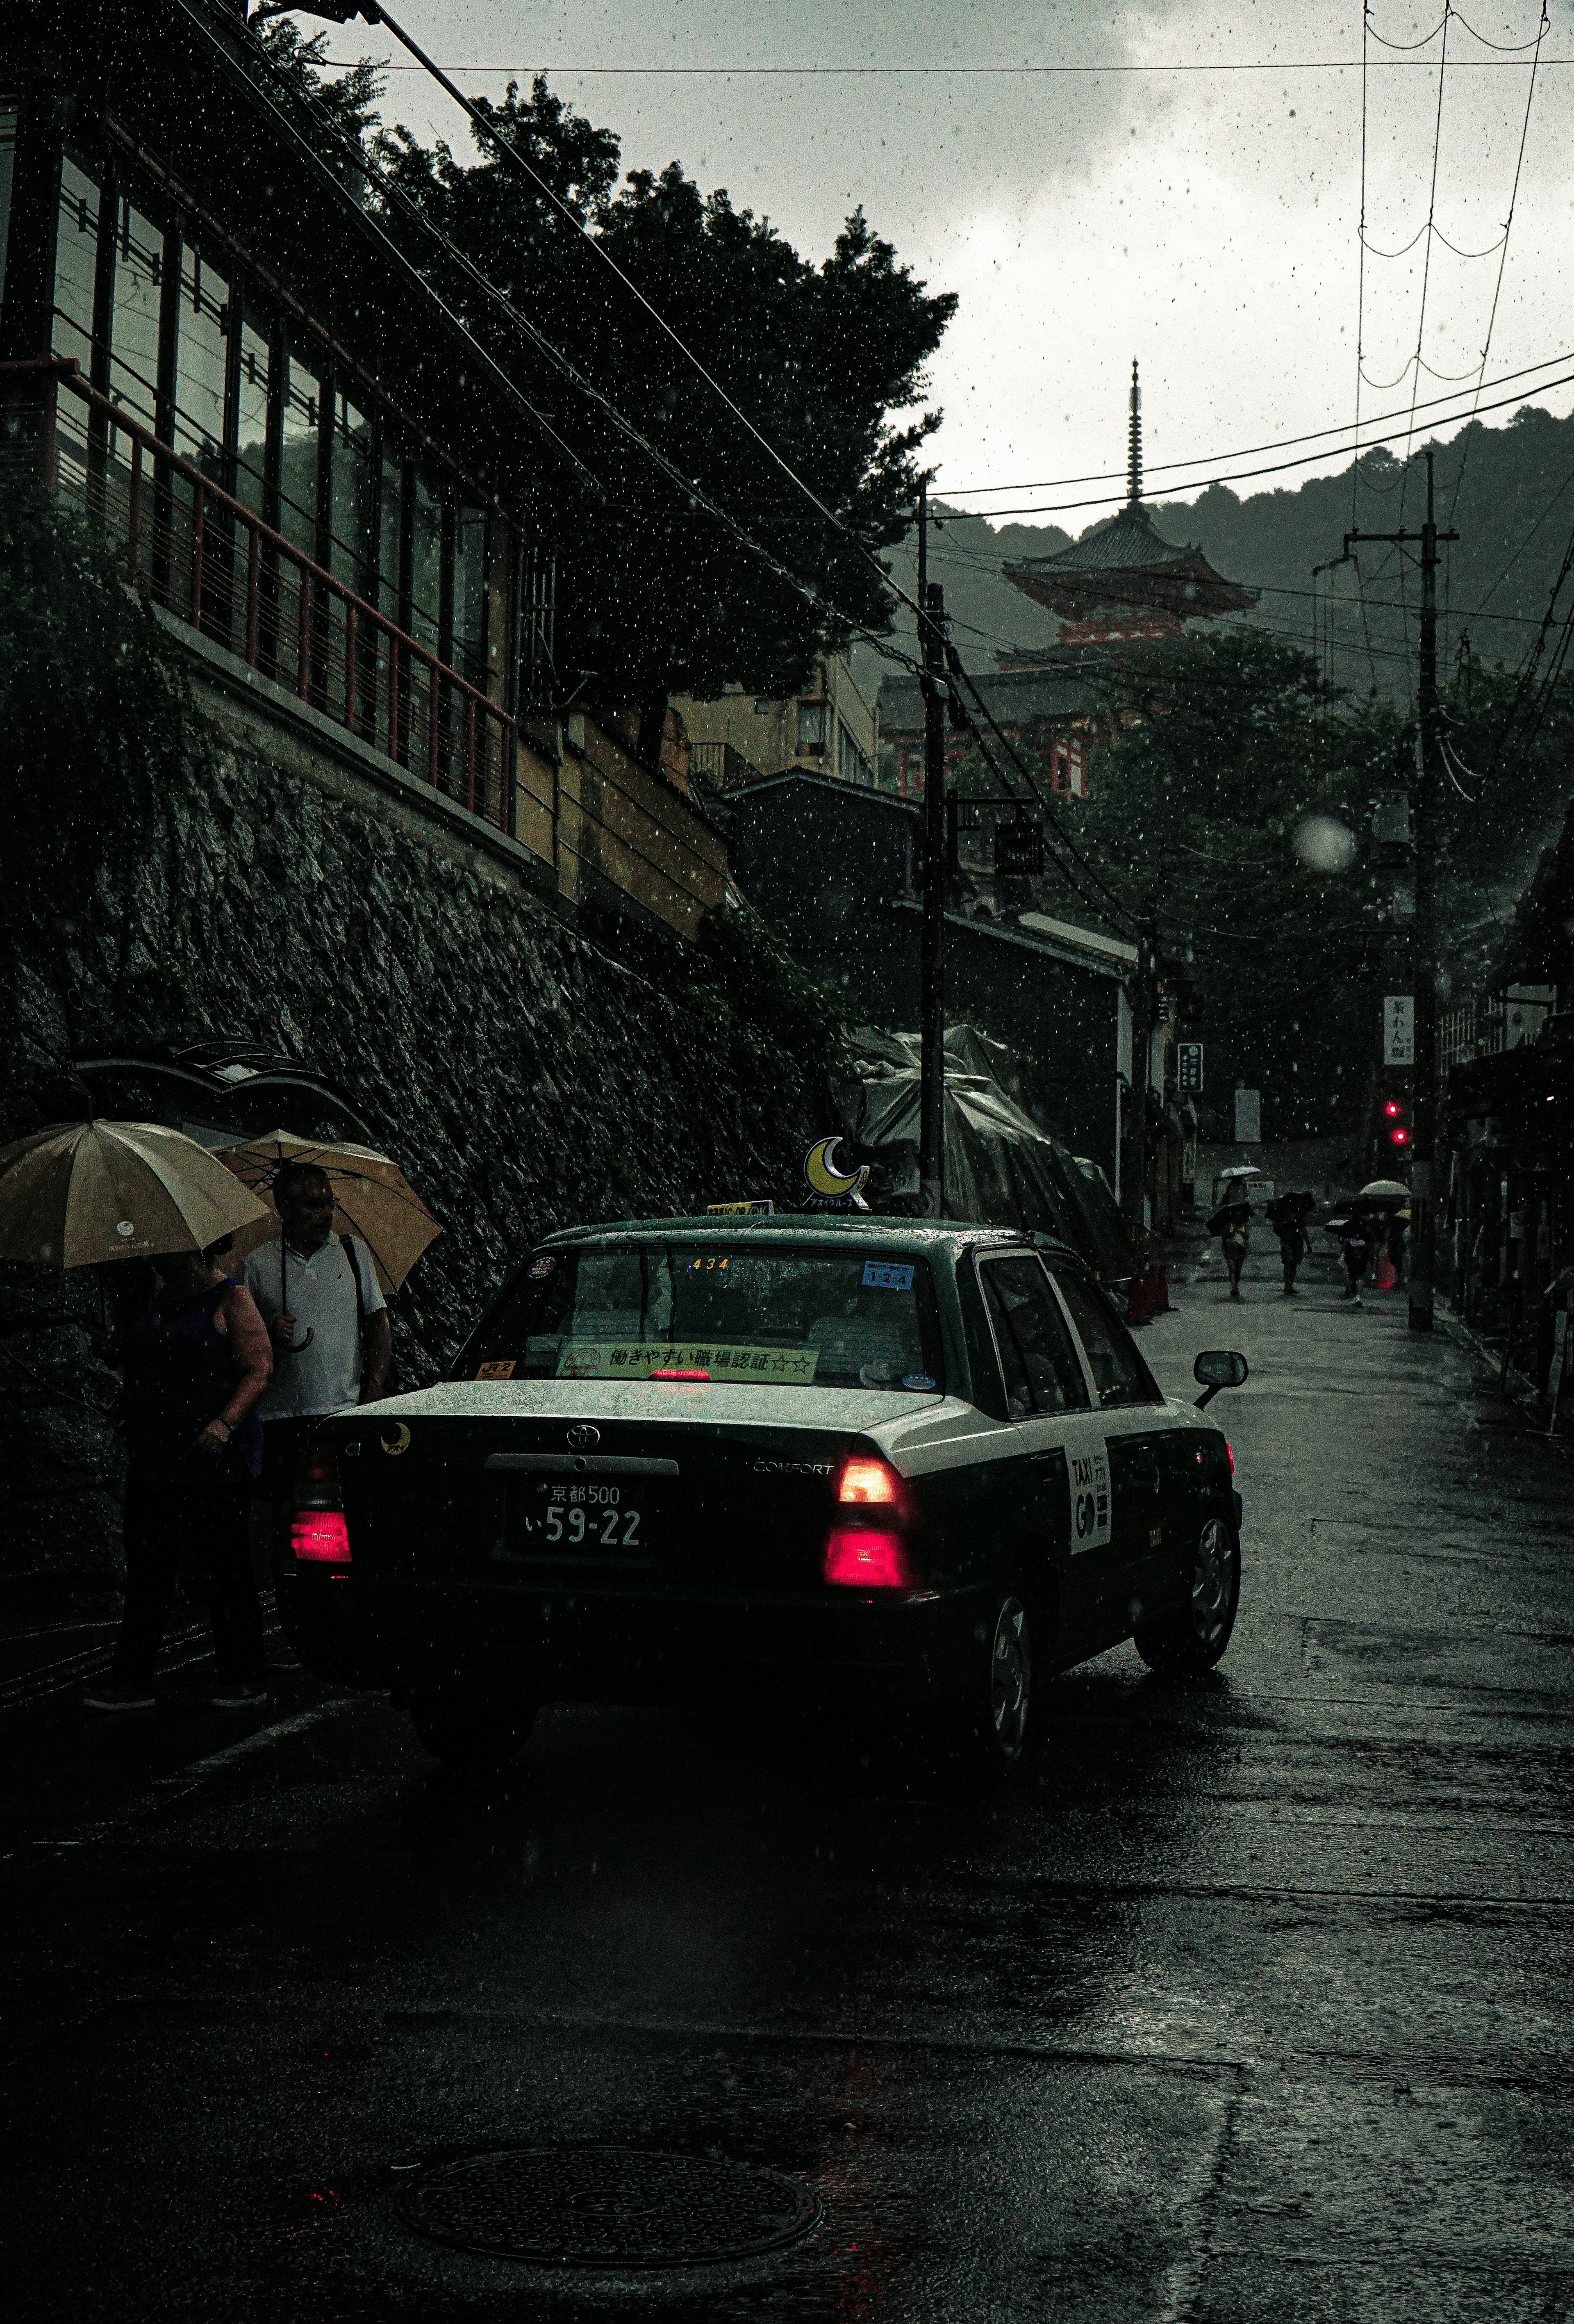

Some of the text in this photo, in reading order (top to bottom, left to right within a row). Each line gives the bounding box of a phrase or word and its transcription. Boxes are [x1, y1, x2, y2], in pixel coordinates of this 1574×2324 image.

[1392, 1000, 1405, 1058] 茶わん坂
[693, 1258, 729, 1269] 434
[609, 1349, 769, 1371] 働きやすい職場認証
[753, 1461, 835, 1475] COMFORT
[1071, 1456, 1093, 1487] TAXI
[546, 1506, 640, 1545] 59-22
